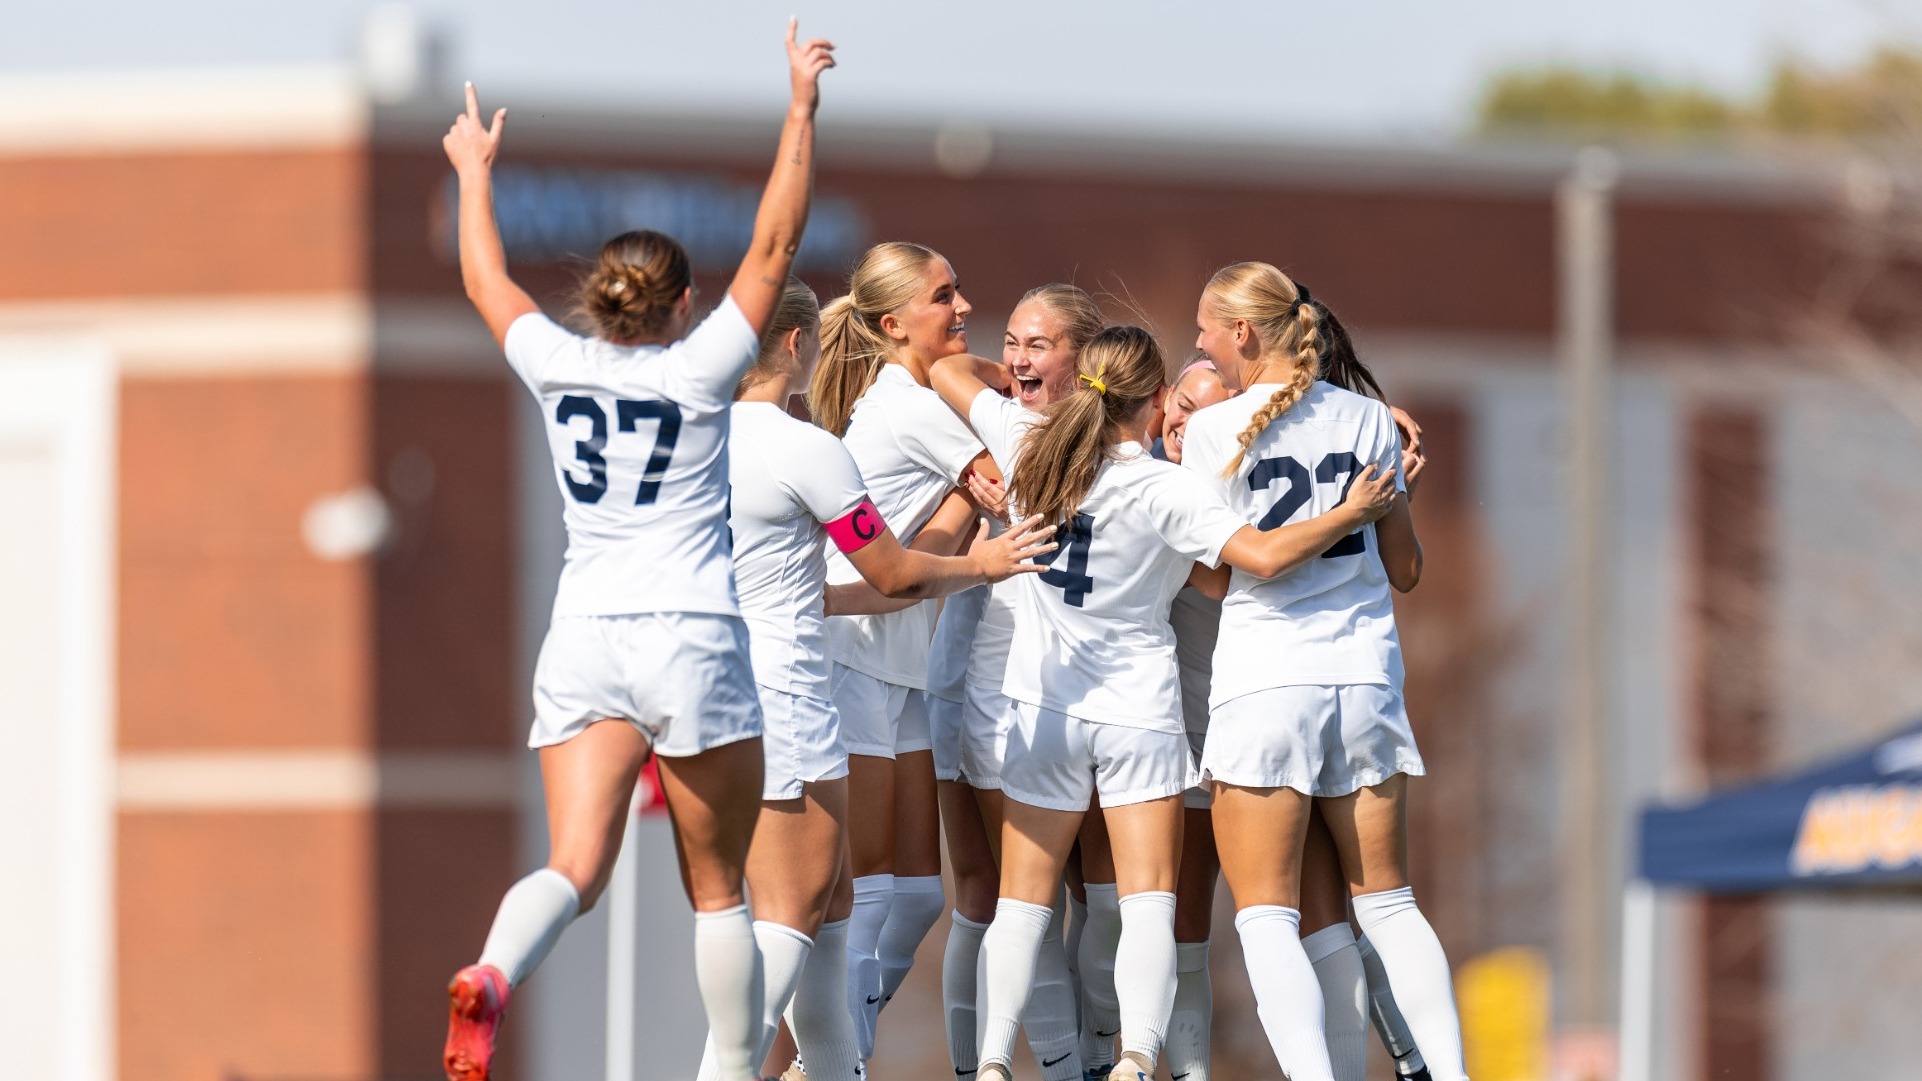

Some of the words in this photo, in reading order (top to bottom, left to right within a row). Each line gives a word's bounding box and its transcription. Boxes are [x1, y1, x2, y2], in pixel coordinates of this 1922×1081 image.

[556, 395, 682, 506] 37
[851, 509, 876, 541] C
[1247, 451, 1366, 559] 22
[1032, 511, 1096, 608] 4
